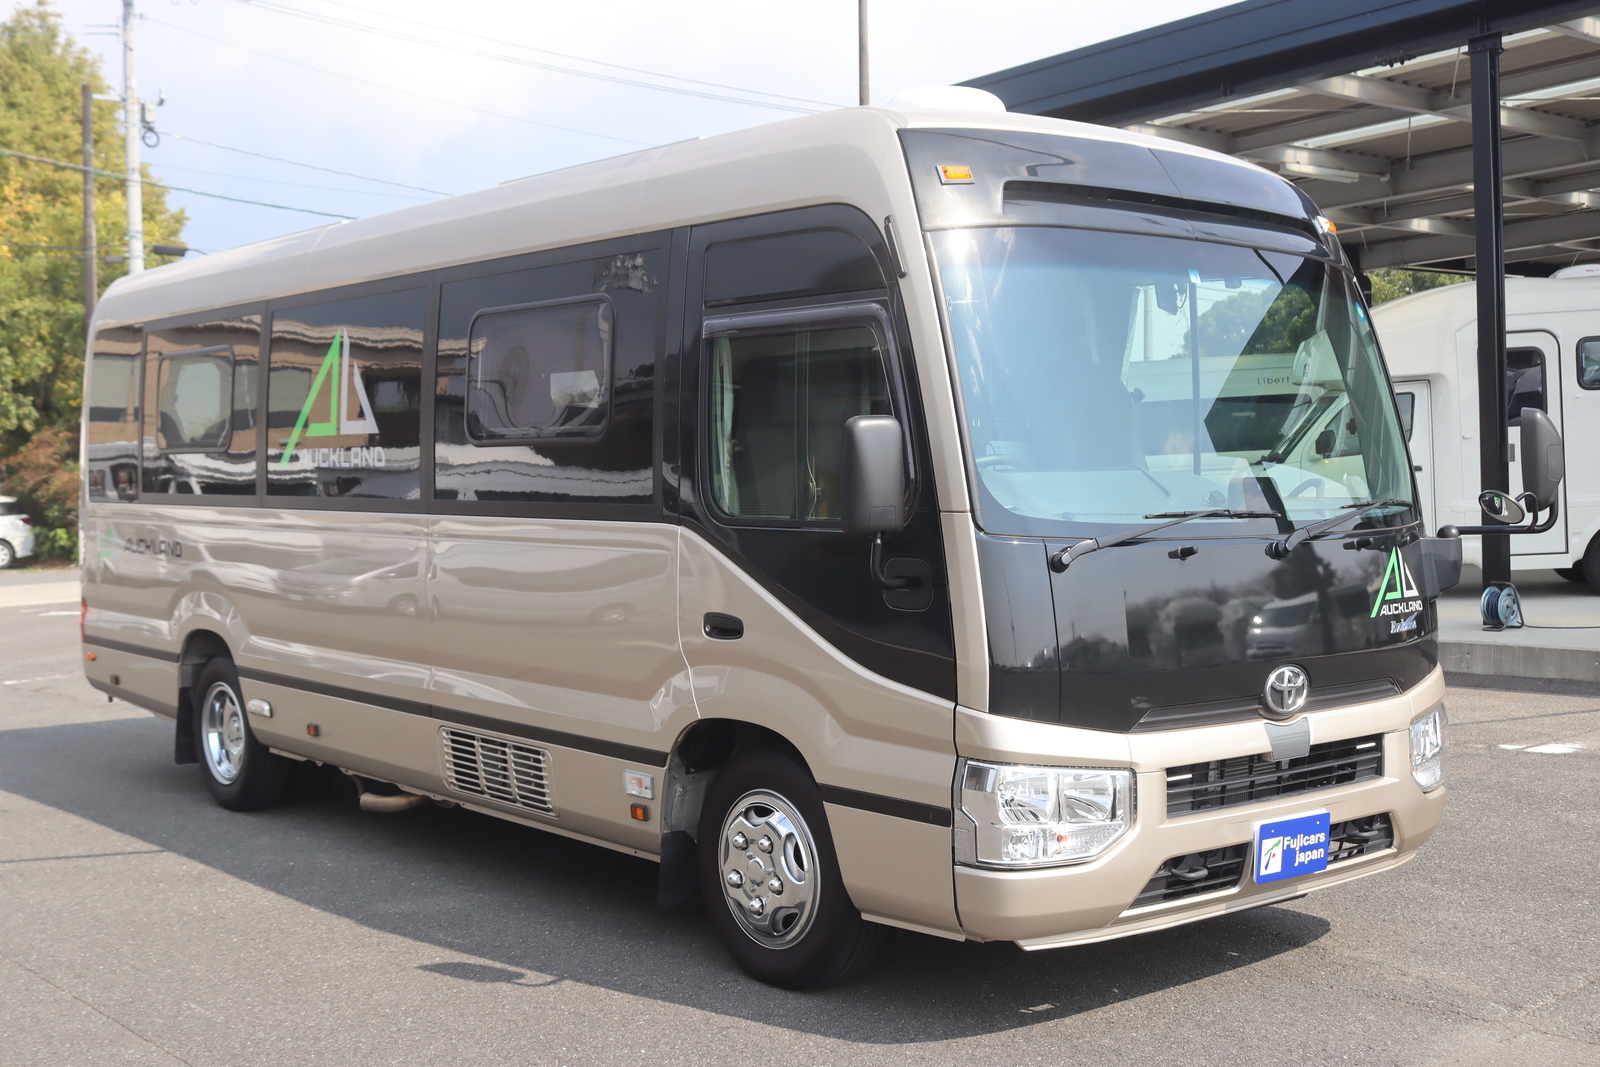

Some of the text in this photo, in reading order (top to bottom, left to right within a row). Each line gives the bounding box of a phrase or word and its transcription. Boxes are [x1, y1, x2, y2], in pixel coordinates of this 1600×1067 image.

[298, 446, 386, 468] AUCKLAND
[123, 537, 183, 558] AUCKLAND
[1380, 600, 1423, 617] AUCKLAND
[1283, 832, 1326, 851] Fujicars
